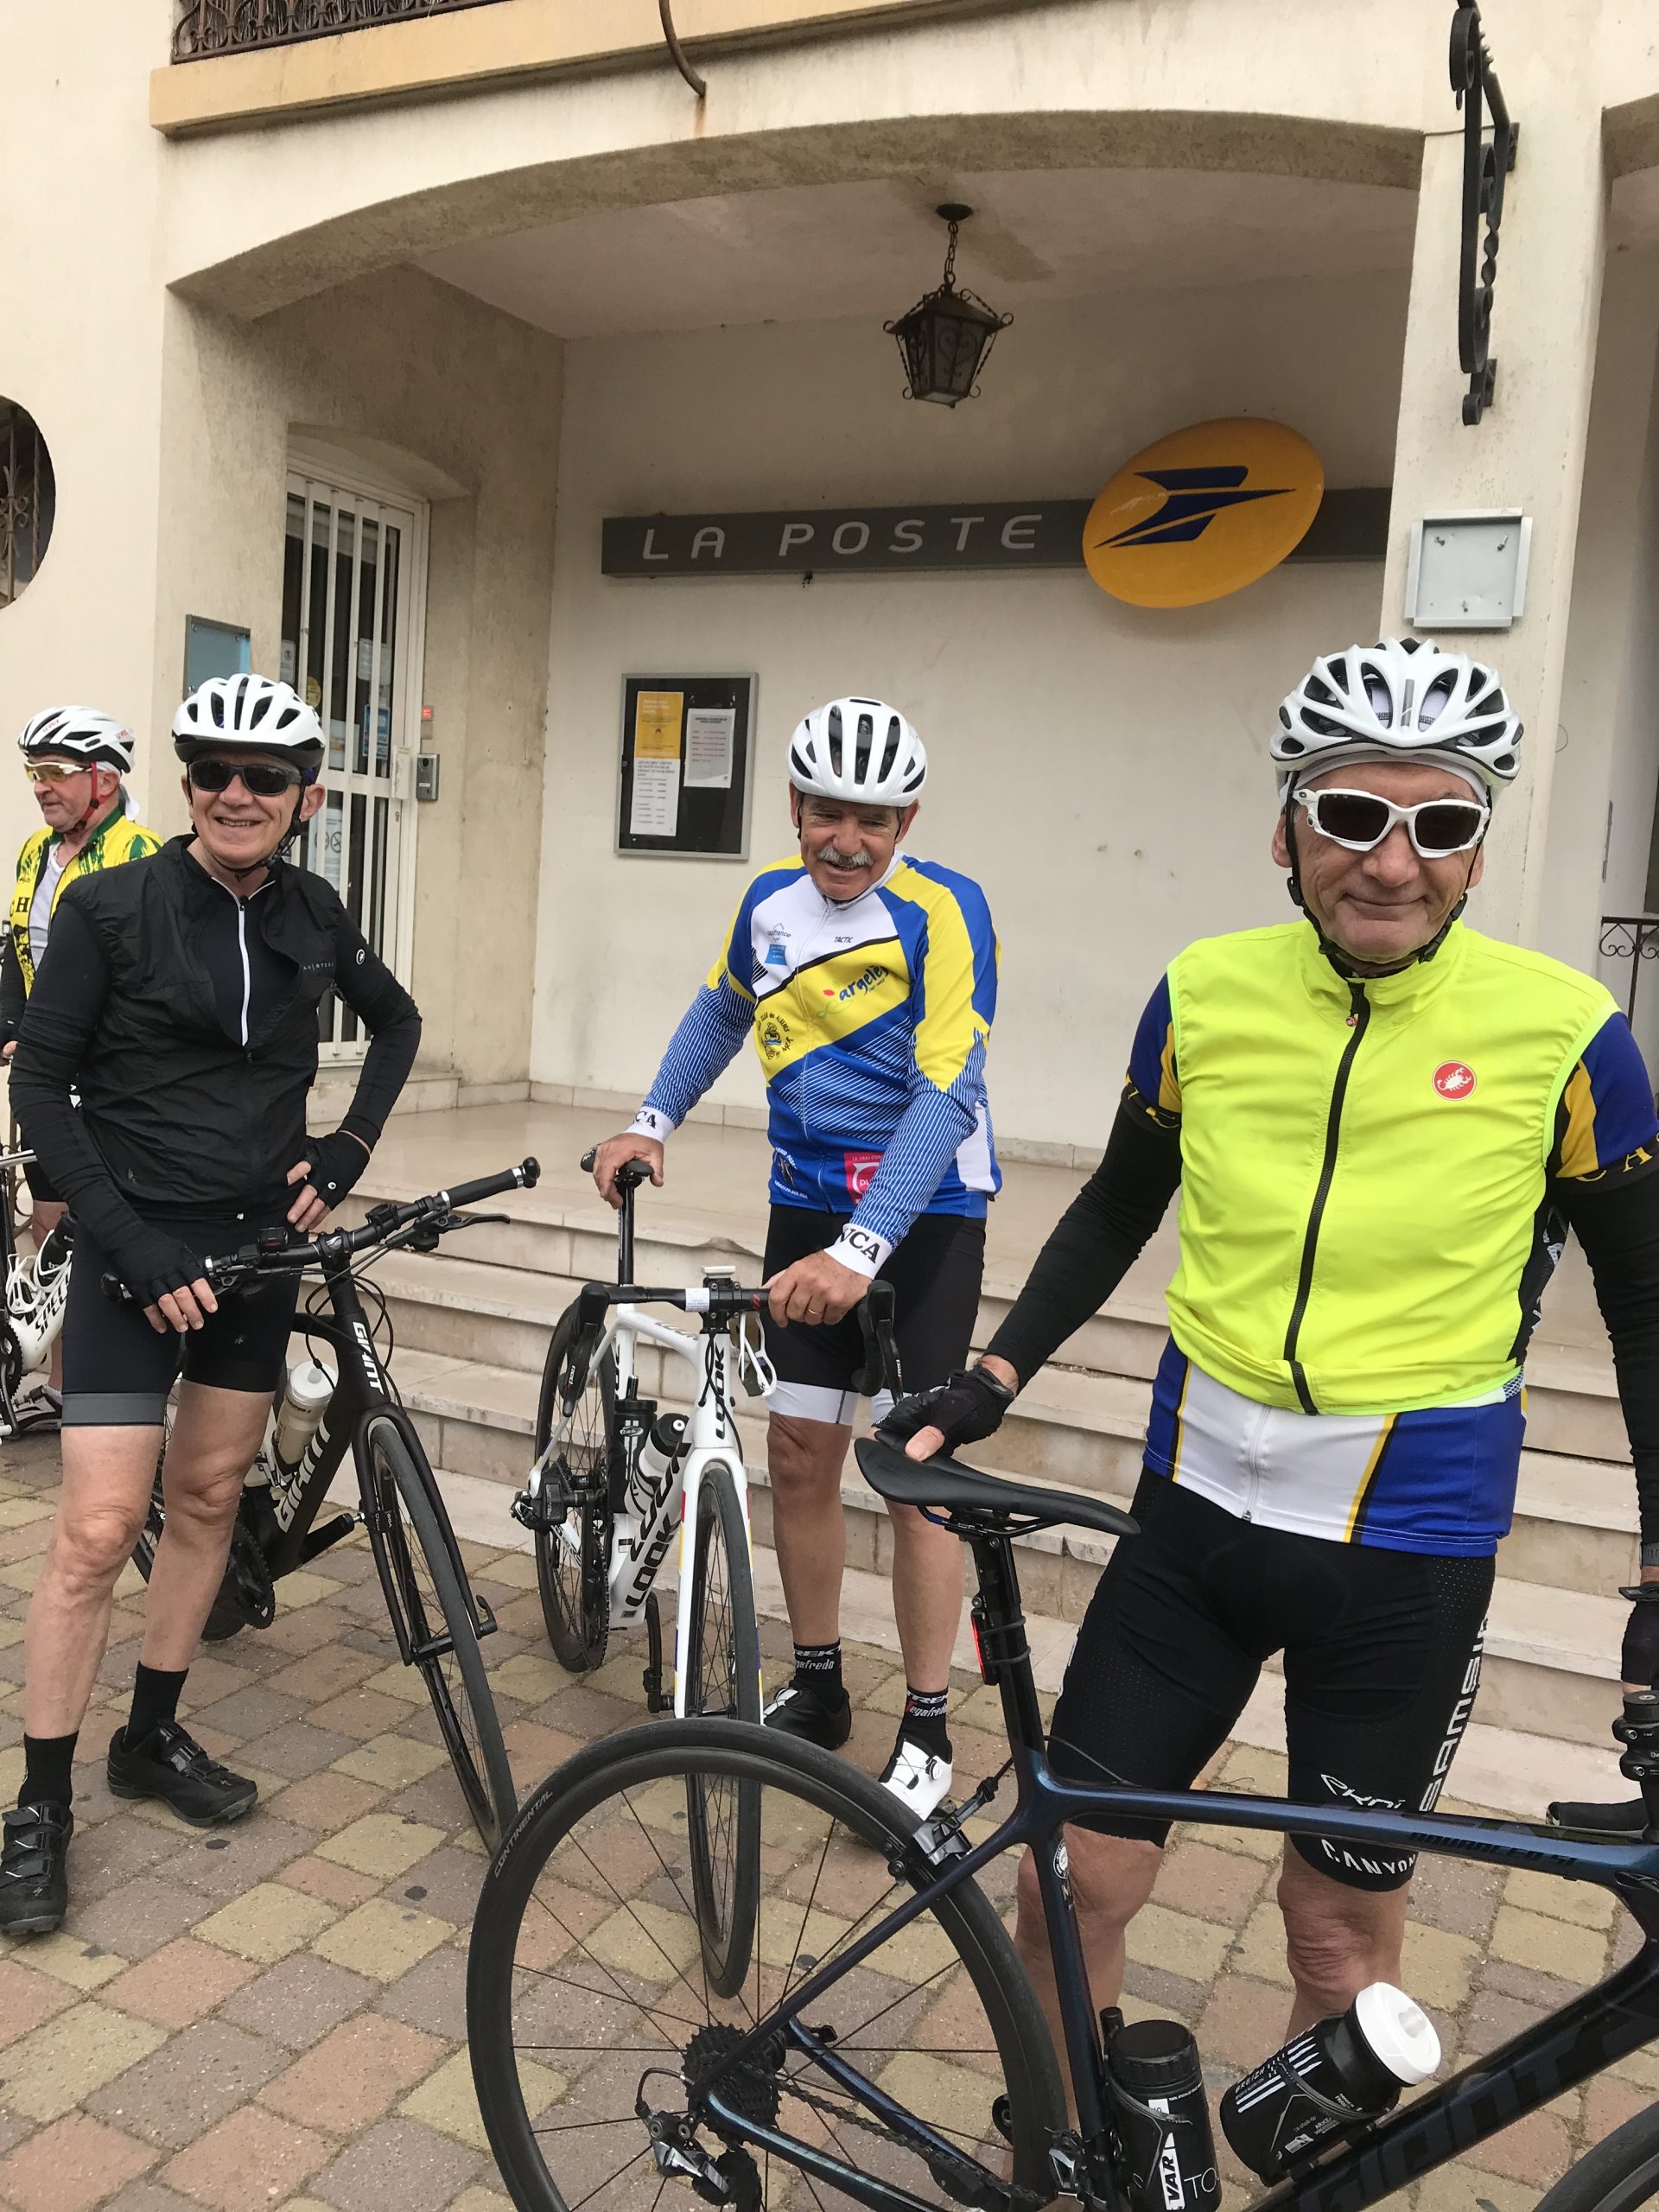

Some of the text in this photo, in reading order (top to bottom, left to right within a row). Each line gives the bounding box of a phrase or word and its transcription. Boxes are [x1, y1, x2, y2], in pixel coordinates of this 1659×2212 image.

[642, 514, 1042, 560] LA POSTE
[840, 1228, 880, 1264] VCA
[353, 1321, 385, 1395] GIANT
[715, 1342, 726, 1440] LOOK
[273, 1417, 332, 1534] GIANT
[625, 1512, 682, 1607] LOOK
[493, 1790, 554, 1878] CONTINENTAL
[1320, 1838, 1417, 1875] CANYON
[1161, 2155, 1181, 2202] VAR
